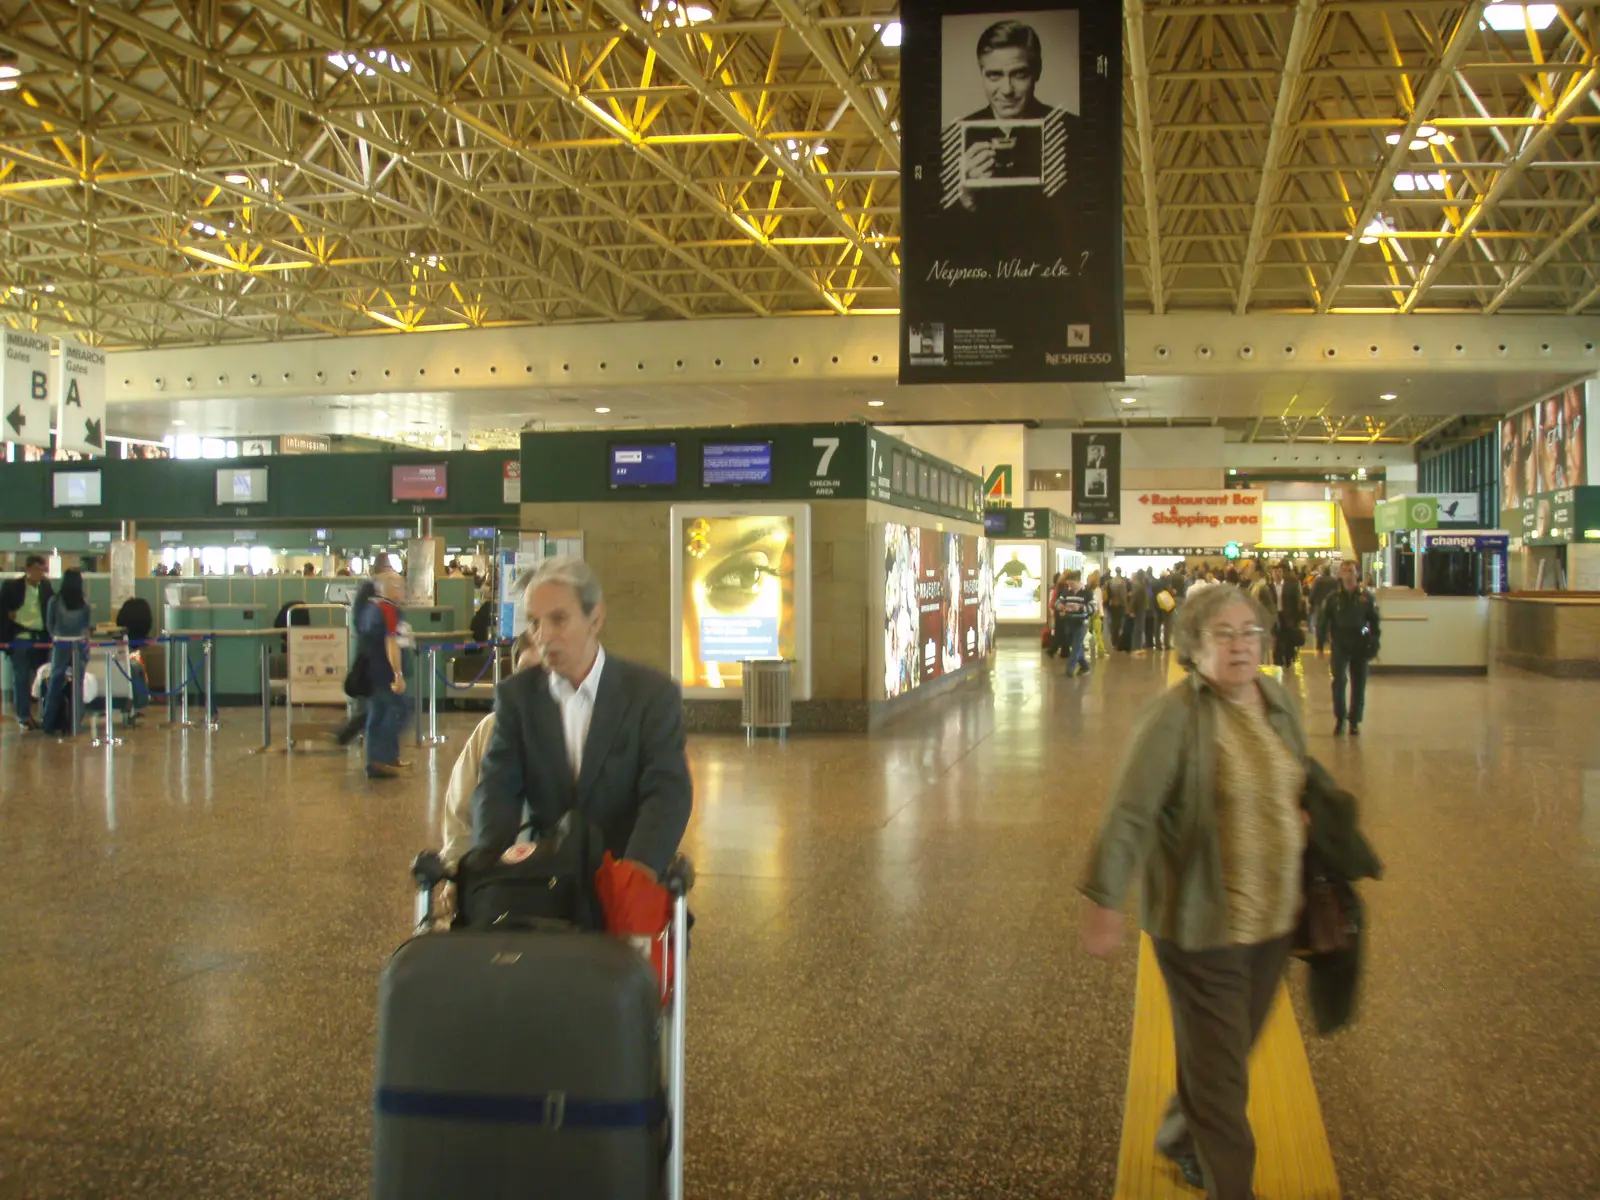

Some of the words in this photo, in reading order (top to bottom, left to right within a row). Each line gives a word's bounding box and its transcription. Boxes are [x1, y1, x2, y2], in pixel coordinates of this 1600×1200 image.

[925, 260, 992, 287] Nespresso.
[997, 258, 1040, 279] What
[1040, 257, 1071, 277] else
[1078, 250, 1090, 276] ?
[6, 333, 50, 352] IMBARCHI
[6, 348, 31, 363] Gates
[66, 347, 105, 365] IMBARCHI
[1045, 352, 1111, 364] NESPRESSO
[66, 360, 88, 375] Gates
[32, 369, 47, 400] B
[66, 378, 81, 407] A
[812, 437, 840, 477] 7
[870, 438, 877, 477] 7
[815, 488, 834, 496] AREA
[1151, 493, 1229, 505] Restaurant
[1232, 493, 1257, 505] Bar
[1022, 511, 1036, 530] 5
[1152, 511, 1220, 528] Shopping
[1223, 515, 1258, 525] area
[1090, 536, 1099, 547] 3
[1431, 535, 1476, 547] change
